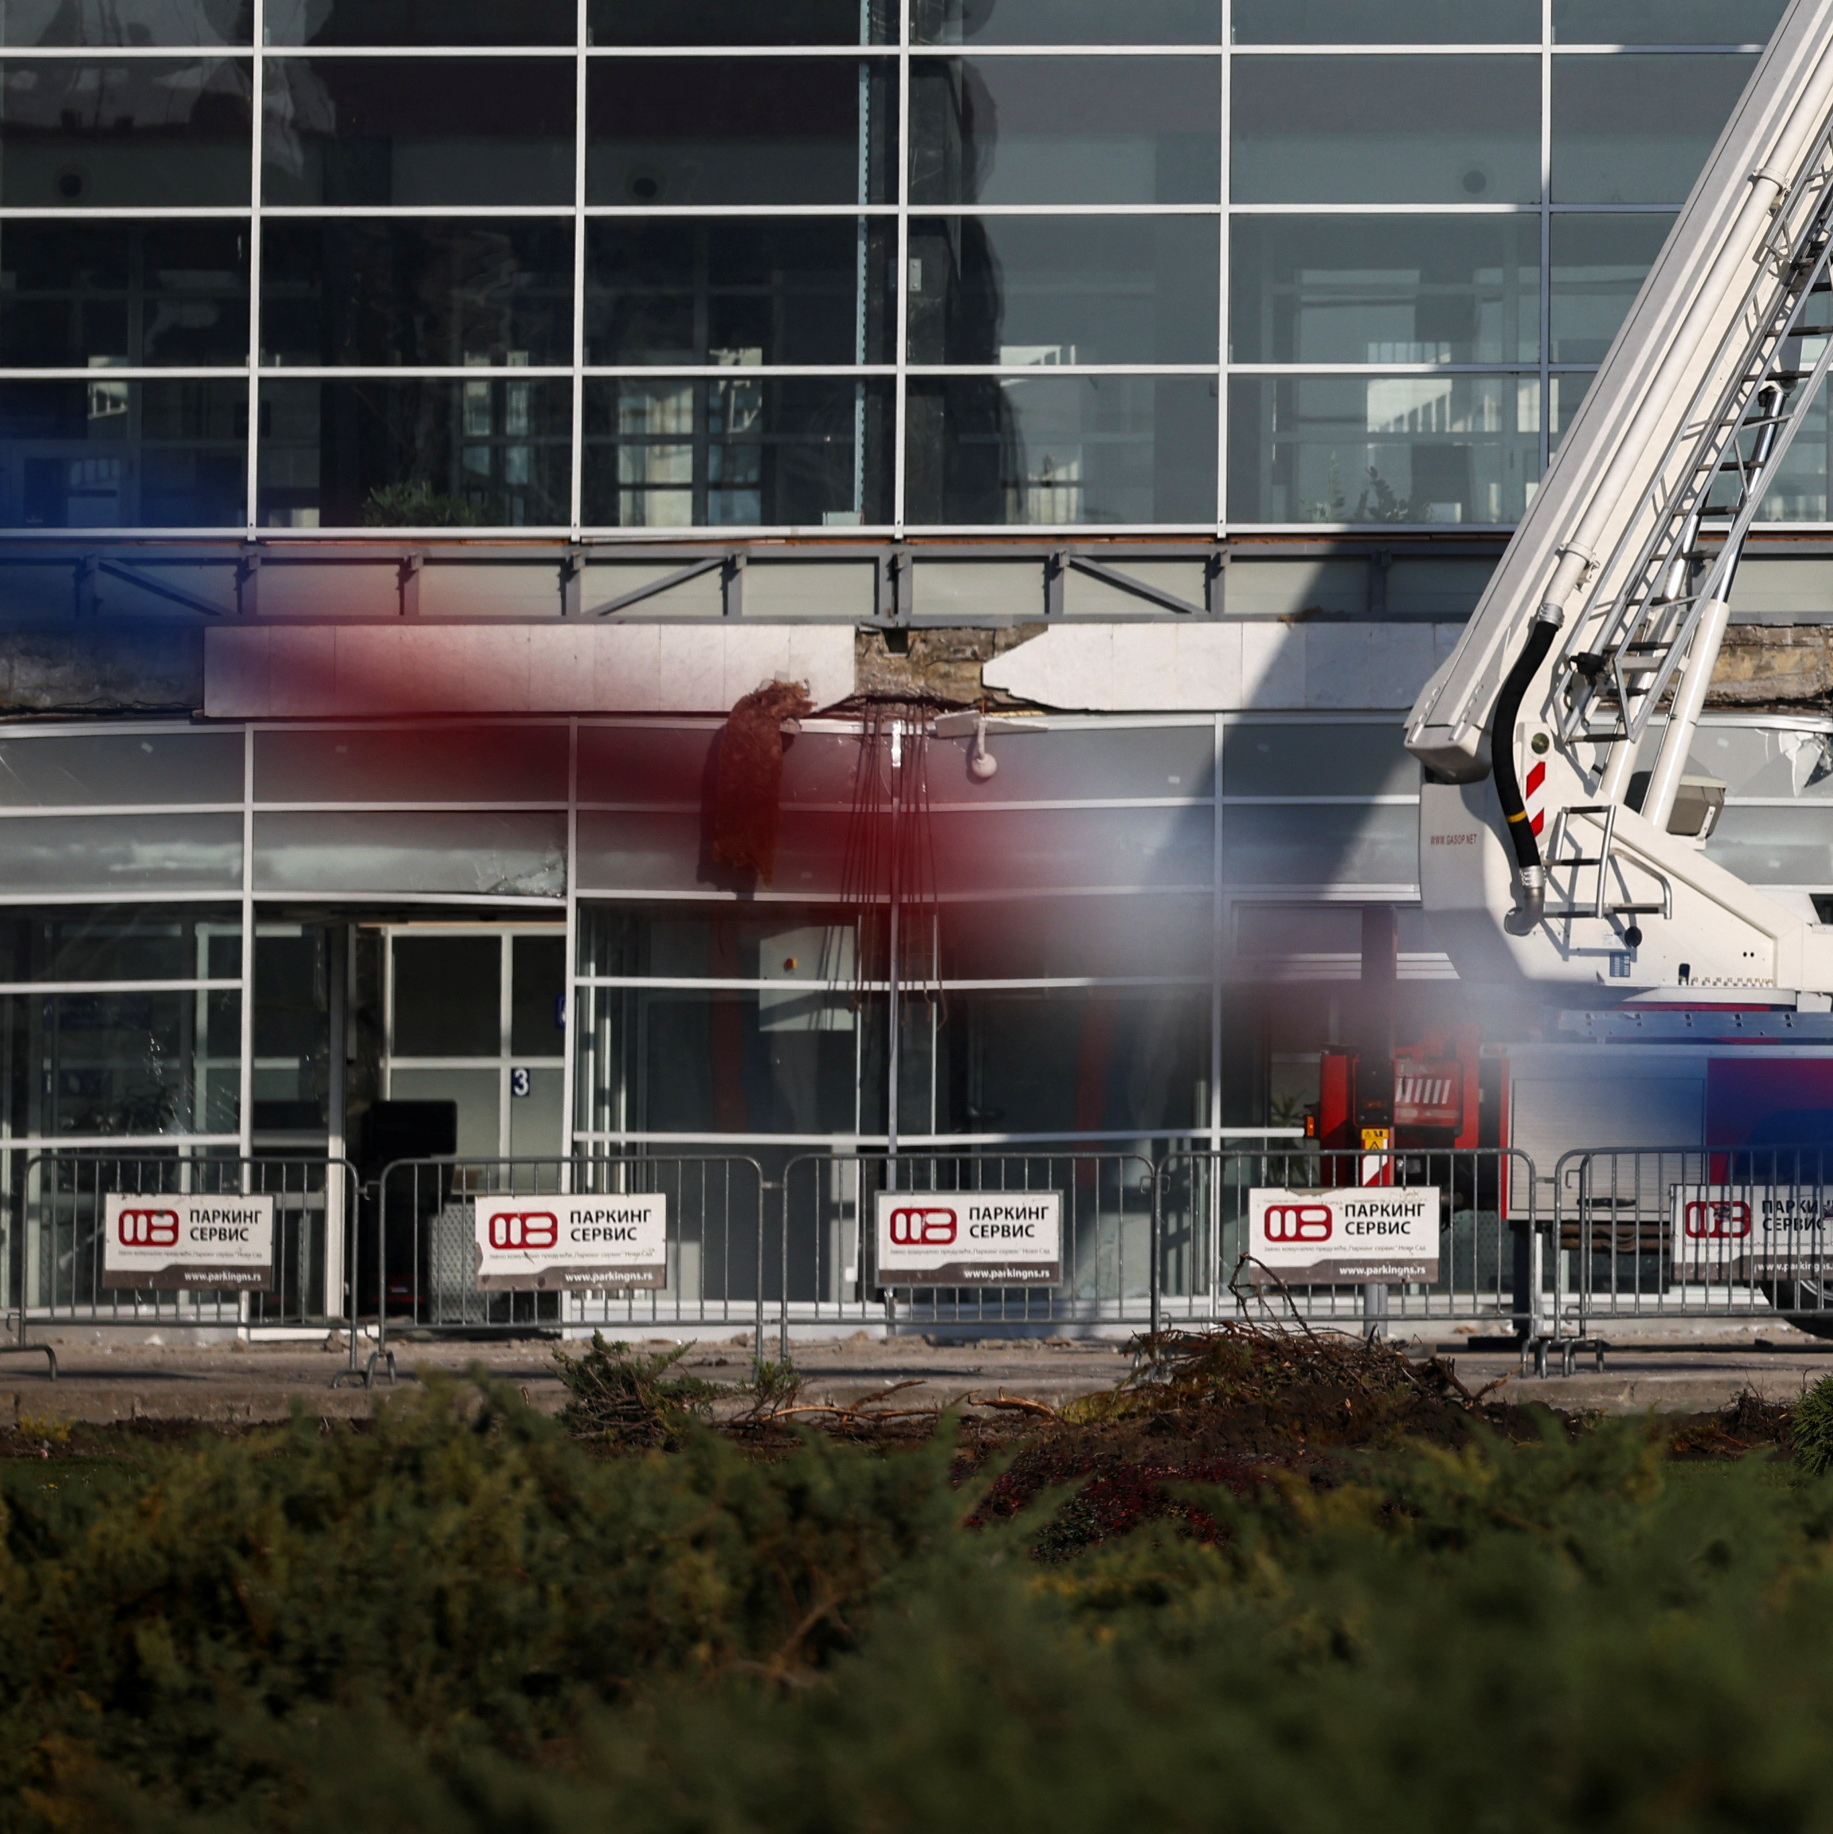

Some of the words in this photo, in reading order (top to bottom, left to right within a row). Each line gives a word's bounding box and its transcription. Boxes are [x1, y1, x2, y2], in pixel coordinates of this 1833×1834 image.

[514, 1069, 529, 1096] 3
[189, 1209, 262, 1224] ПАРКИНГ
[570, 1209, 652, 1224] ПАРКИНГ
[969, 1206, 1049, 1221] ПАРКИНГ
[1344, 1203, 1426, 1218] ПАРКИНГ
[190, 1227, 249, 1242] СЕРВИС
[570, 1227, 637, 1242] СЕРВИС
[969, 1224, 1035, 1238] СЕРВИС
[1345, 1221, 1411, 1235] СЕРВИС
[184, 1271, 262, 1283] www.parkingns.rs
[565, 1271, 653, 1284] www.parkingns.rs
[963, 1268, 1050, 1280] www.parkingns.rs
[1339, 1266, 1426, 1277] www.parkingns.rs
